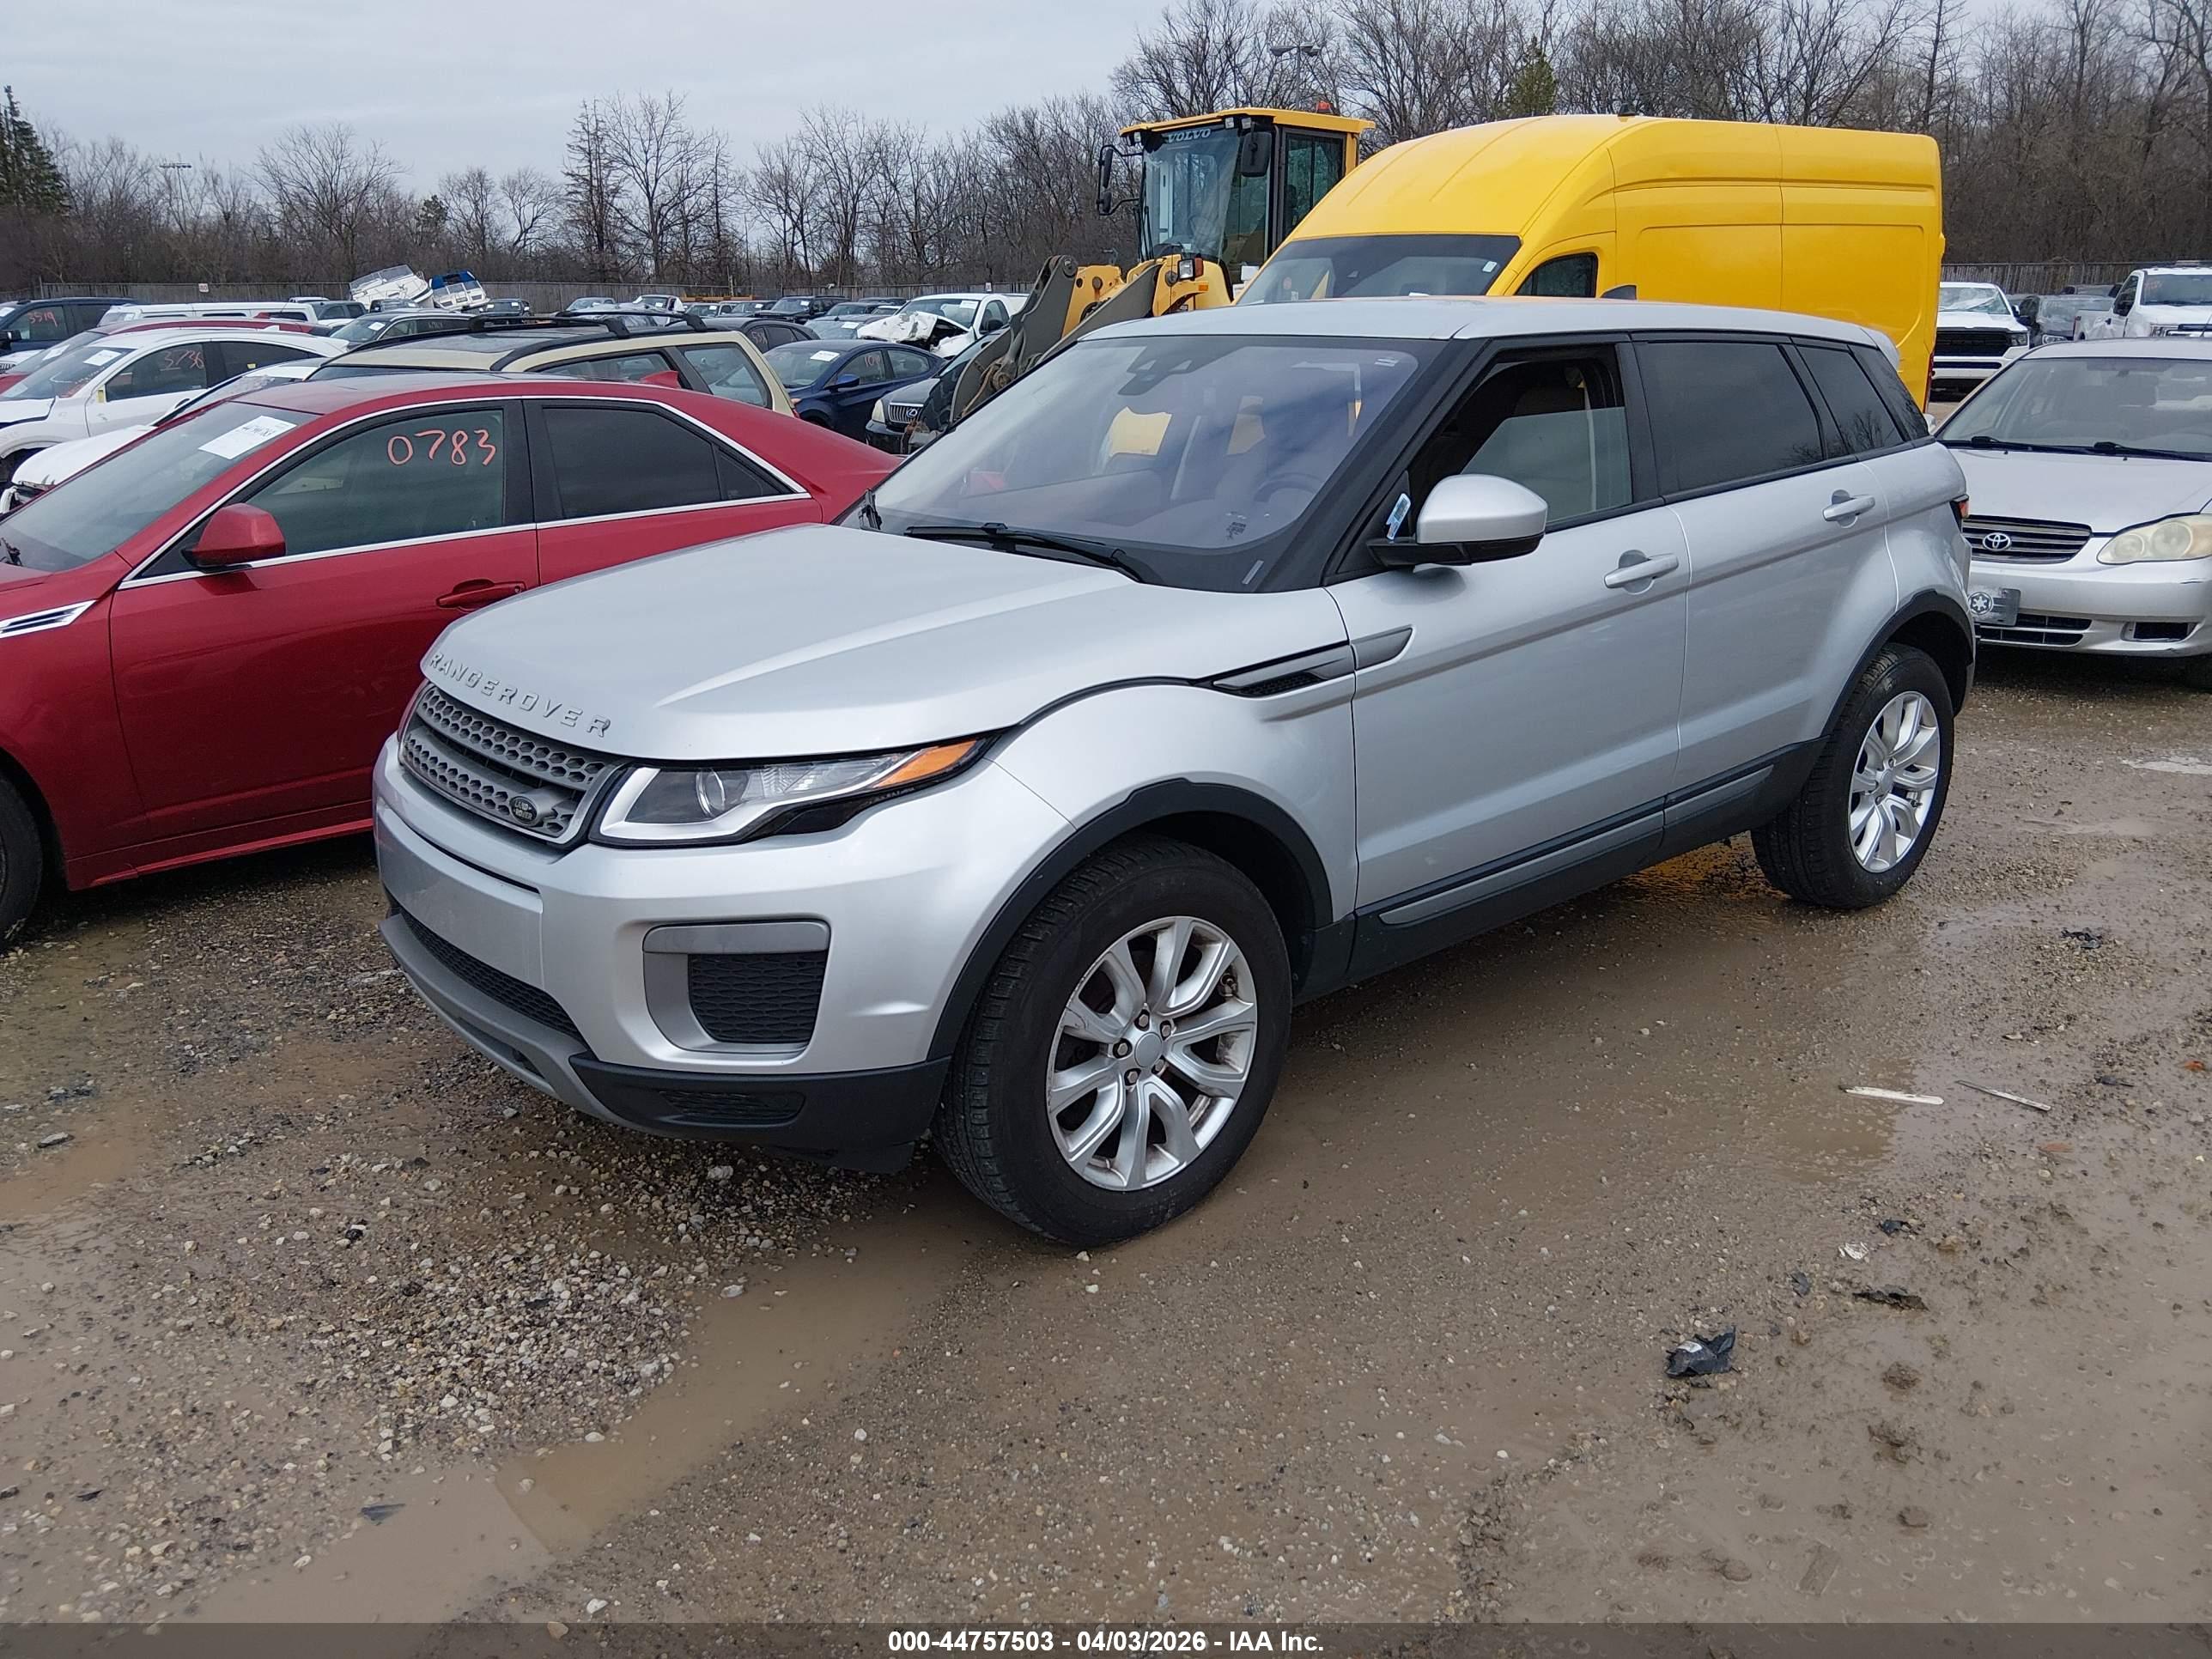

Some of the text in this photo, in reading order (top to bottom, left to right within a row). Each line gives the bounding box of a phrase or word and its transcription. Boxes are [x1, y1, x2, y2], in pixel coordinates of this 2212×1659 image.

[1168, 128, 1212, 143] VOLVO
[387, 428, 496, 465] 0783
[514, 799, 529, 811] LAND
[515, 809, 533, 820] ROVER
